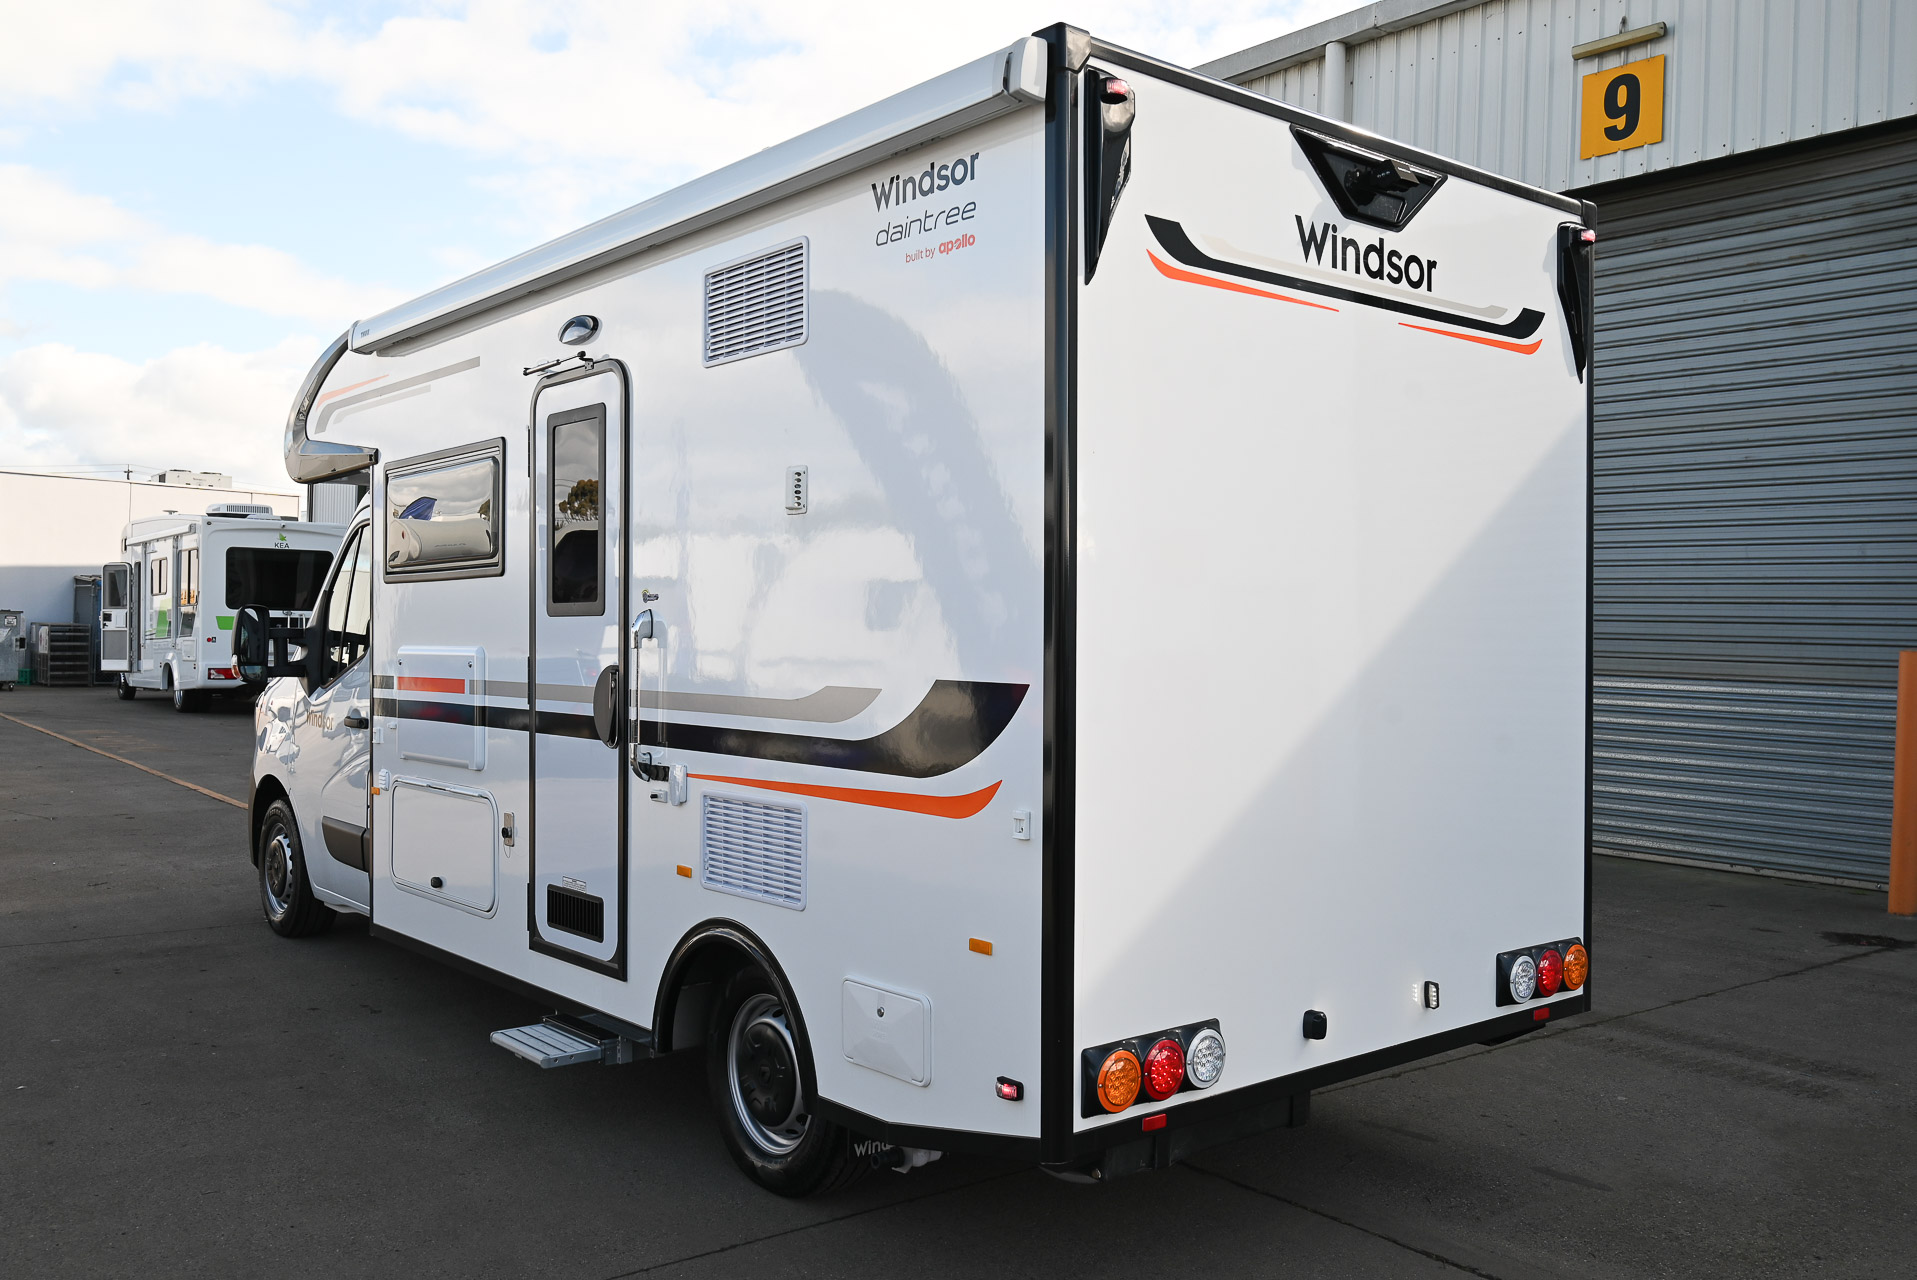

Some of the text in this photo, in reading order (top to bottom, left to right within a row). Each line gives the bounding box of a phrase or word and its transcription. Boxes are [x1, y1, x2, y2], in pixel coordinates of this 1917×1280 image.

[1603, 73, 1641, 142] 9
[871, 152, 980, 213] Windsor
[875, 201, 977, 247] daintree
[905, 233, 976, 263] built by apollo
[1294, 214, 1438, 293] Windsor
